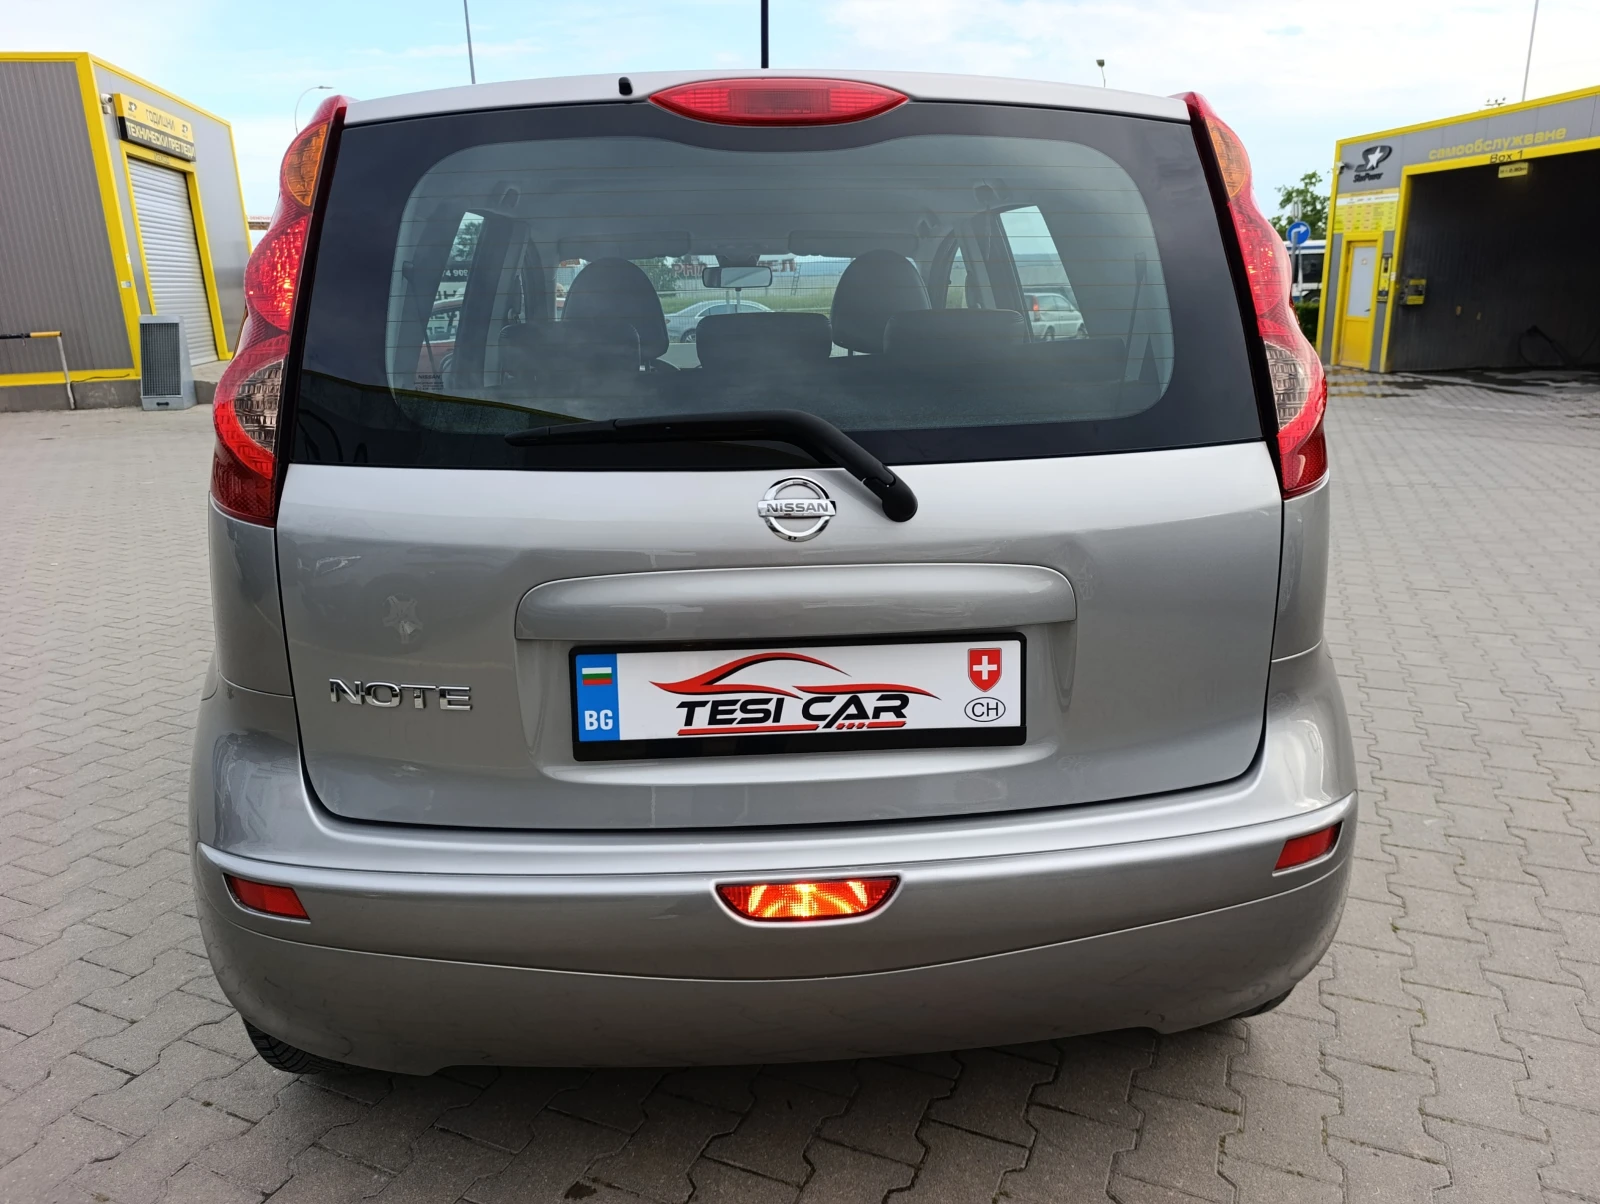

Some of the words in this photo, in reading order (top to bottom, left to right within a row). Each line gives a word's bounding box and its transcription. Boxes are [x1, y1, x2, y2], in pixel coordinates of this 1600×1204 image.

[146, 109, 175, 132] ГОДИШНИ
[1428, 127, 1567, 160] самообслужване
[1490, 153, 1513, 164] Box
[1517, 149, 1523, 160] 1
[766, 502, 829, 513] NISSAN
[329, 678, 472, 711] NOTE
[584, 709, 614, 731] BG
[676, 697, 786, 727] TESI
[801, 693, 908, 729] CAR
[971, 702, 999, 718] CH
